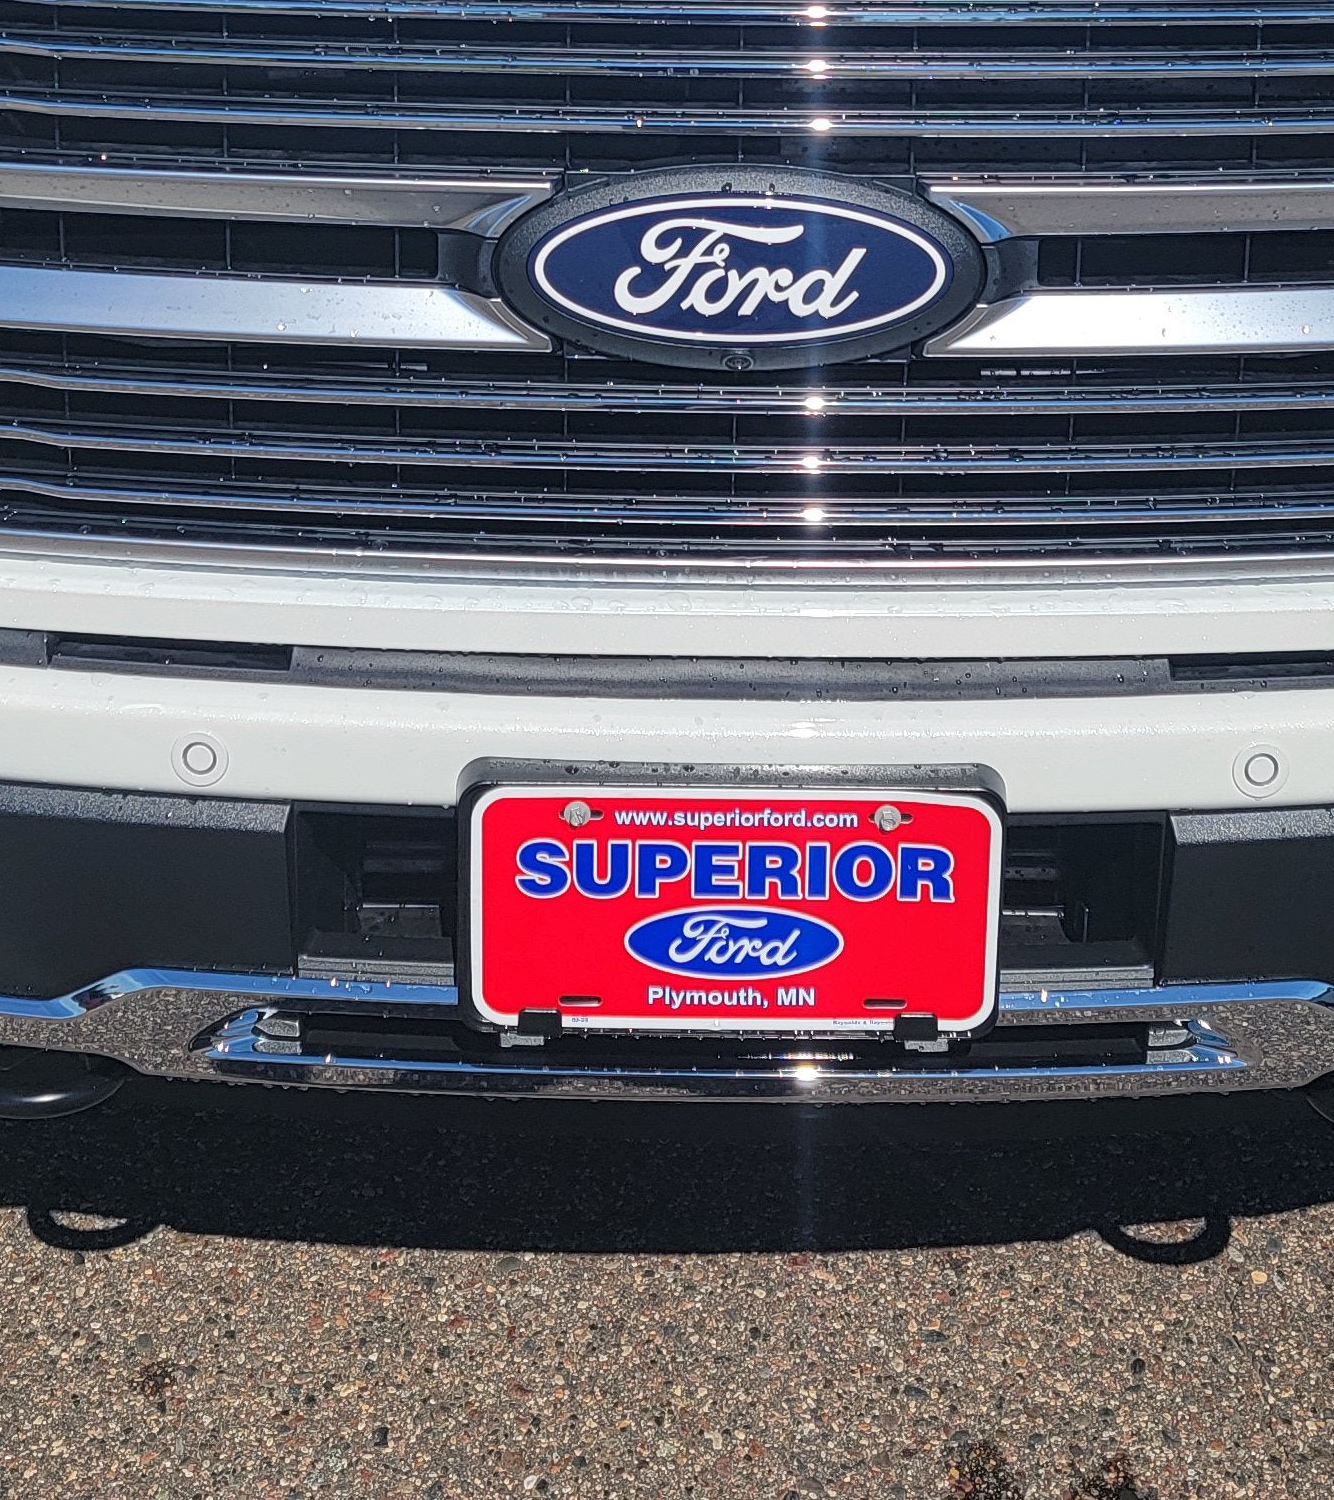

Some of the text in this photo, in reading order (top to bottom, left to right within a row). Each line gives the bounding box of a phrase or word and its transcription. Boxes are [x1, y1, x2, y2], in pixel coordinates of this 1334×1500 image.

[613, 218, 867, 320] Ford
[614, 807, 859, 830] www.superiorford.com
[515, 838, 955, 903] SUPERIOR
[667, 913, 800, 966] Ford
[647, 985, 816, 1009] Plymouth, MN
